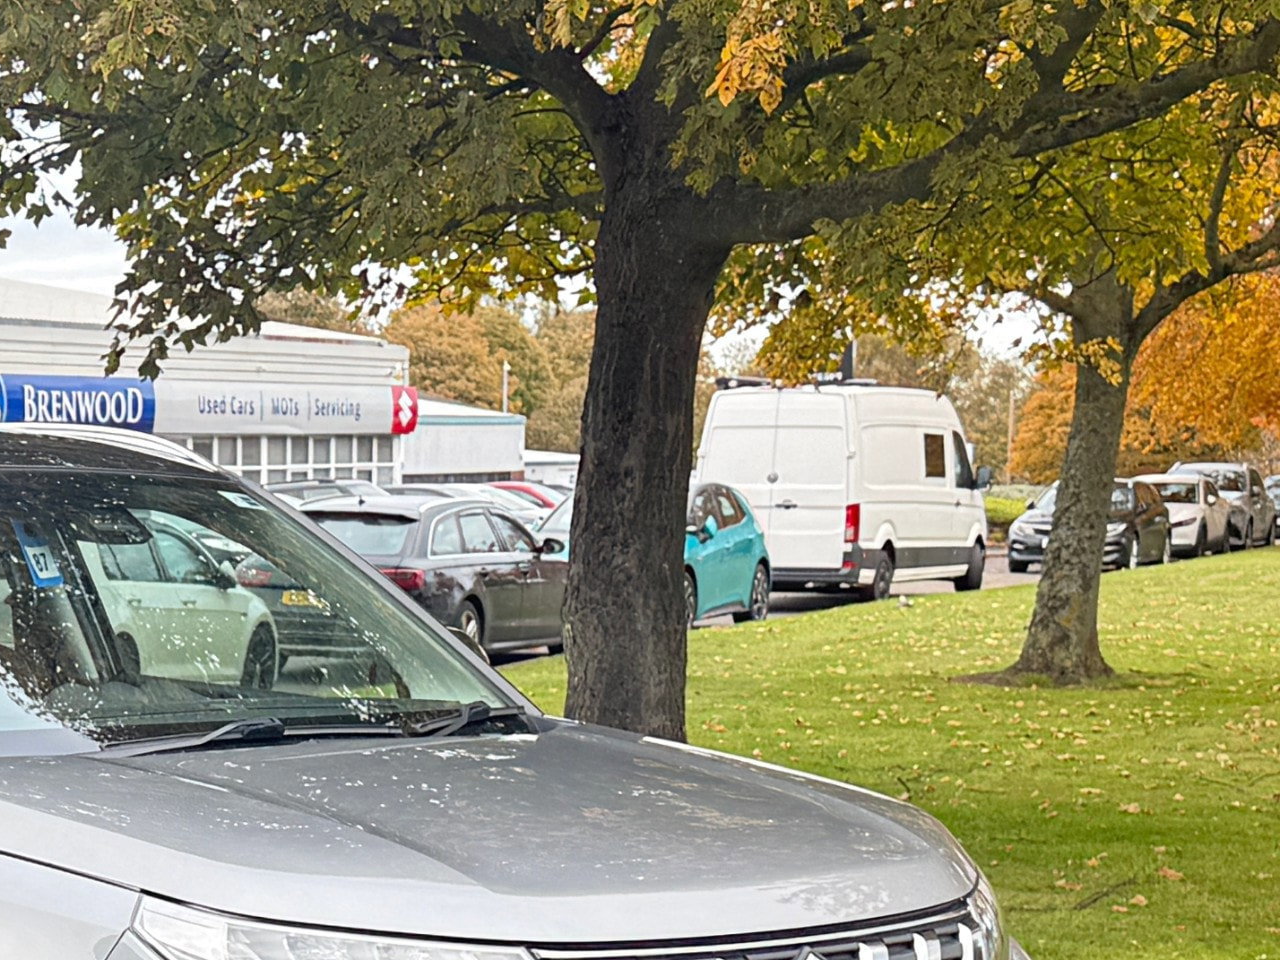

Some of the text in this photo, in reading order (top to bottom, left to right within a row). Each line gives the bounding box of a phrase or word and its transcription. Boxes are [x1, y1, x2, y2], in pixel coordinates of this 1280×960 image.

[23, 384, 144, 424] BRENWOOD
[198, 395, 361, 421] Used Cars MOTs Servicing
